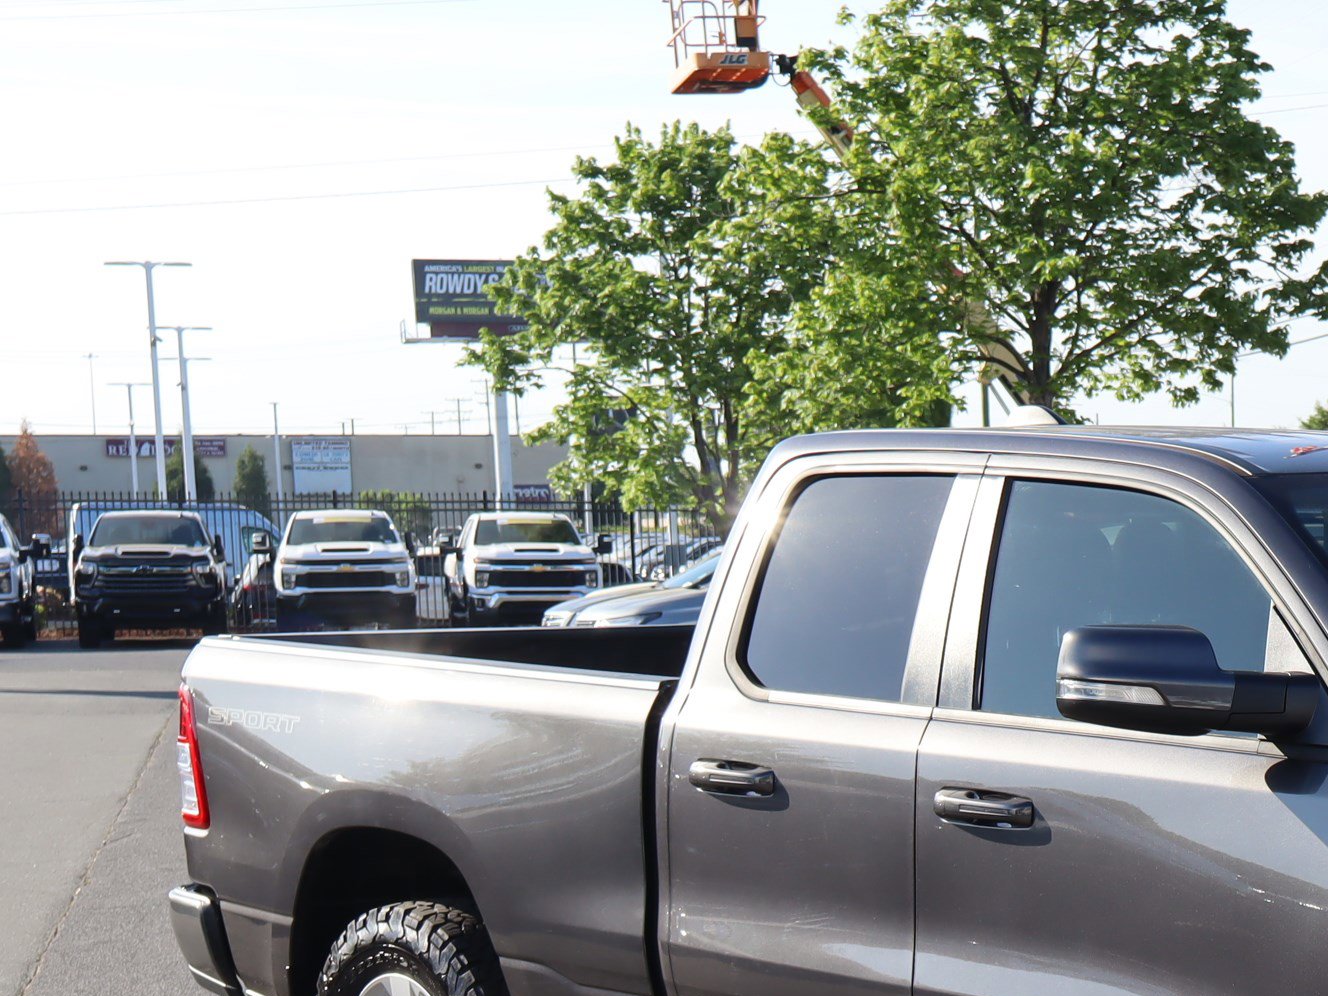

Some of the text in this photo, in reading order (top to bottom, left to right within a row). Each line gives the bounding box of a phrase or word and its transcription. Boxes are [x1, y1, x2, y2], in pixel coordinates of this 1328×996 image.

[719, 54, 747, 65] JLG
[424, 265, 462, 273] AMERICA'S
[463, 265, 494, 273] LARGEST
[429, 306, 489, 315] MORGAN & MORGAN
[207, 706, 301, 734] SPORT
